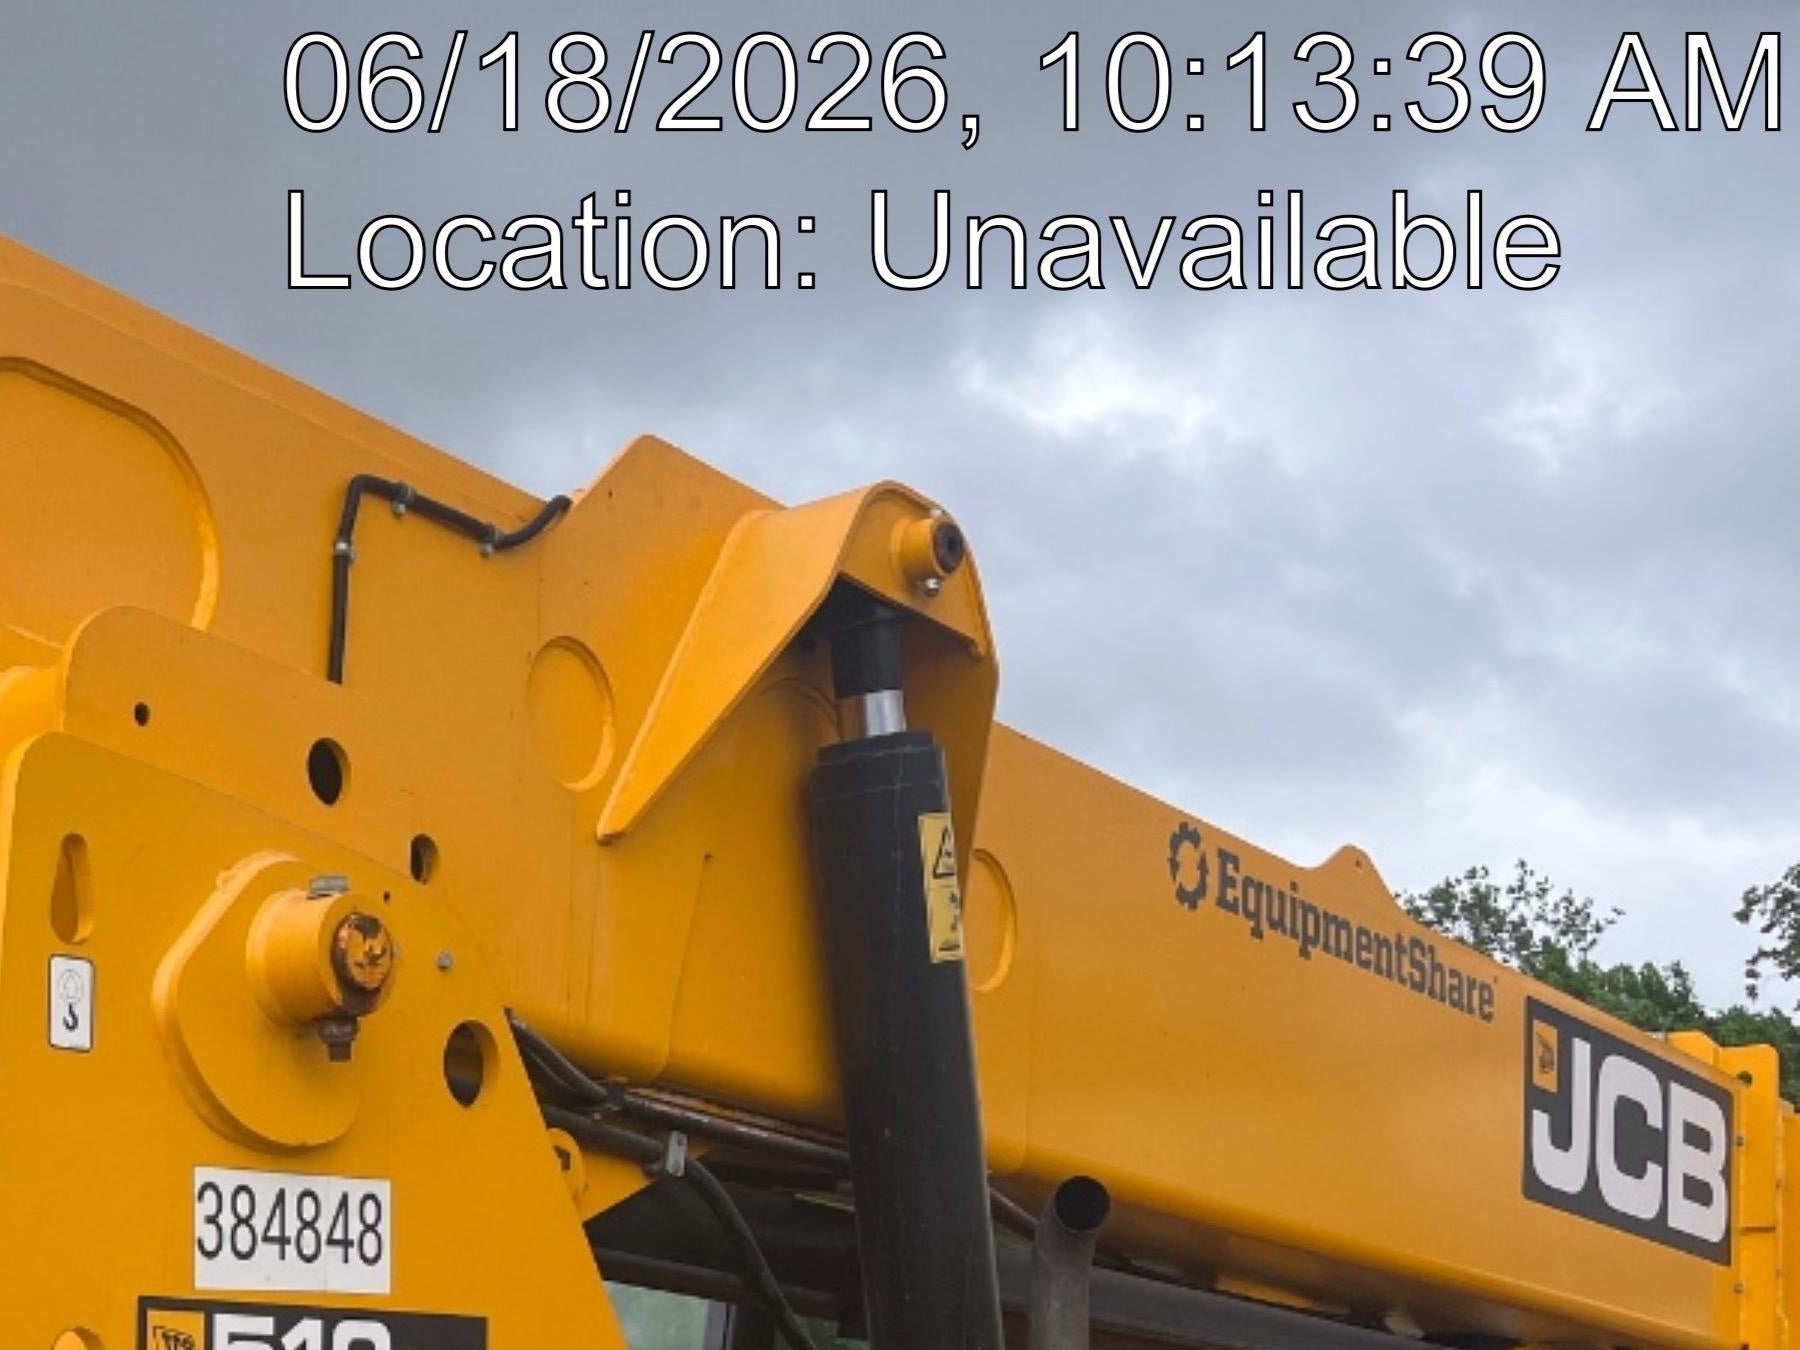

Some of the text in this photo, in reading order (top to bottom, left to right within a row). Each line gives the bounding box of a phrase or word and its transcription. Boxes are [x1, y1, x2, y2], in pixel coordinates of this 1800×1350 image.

[1215, 848, 1495, 1023] EquipmentShare
[196, 1180, 384, 1267] 384848
[1531, 1036, 1728, 1244] JCB
